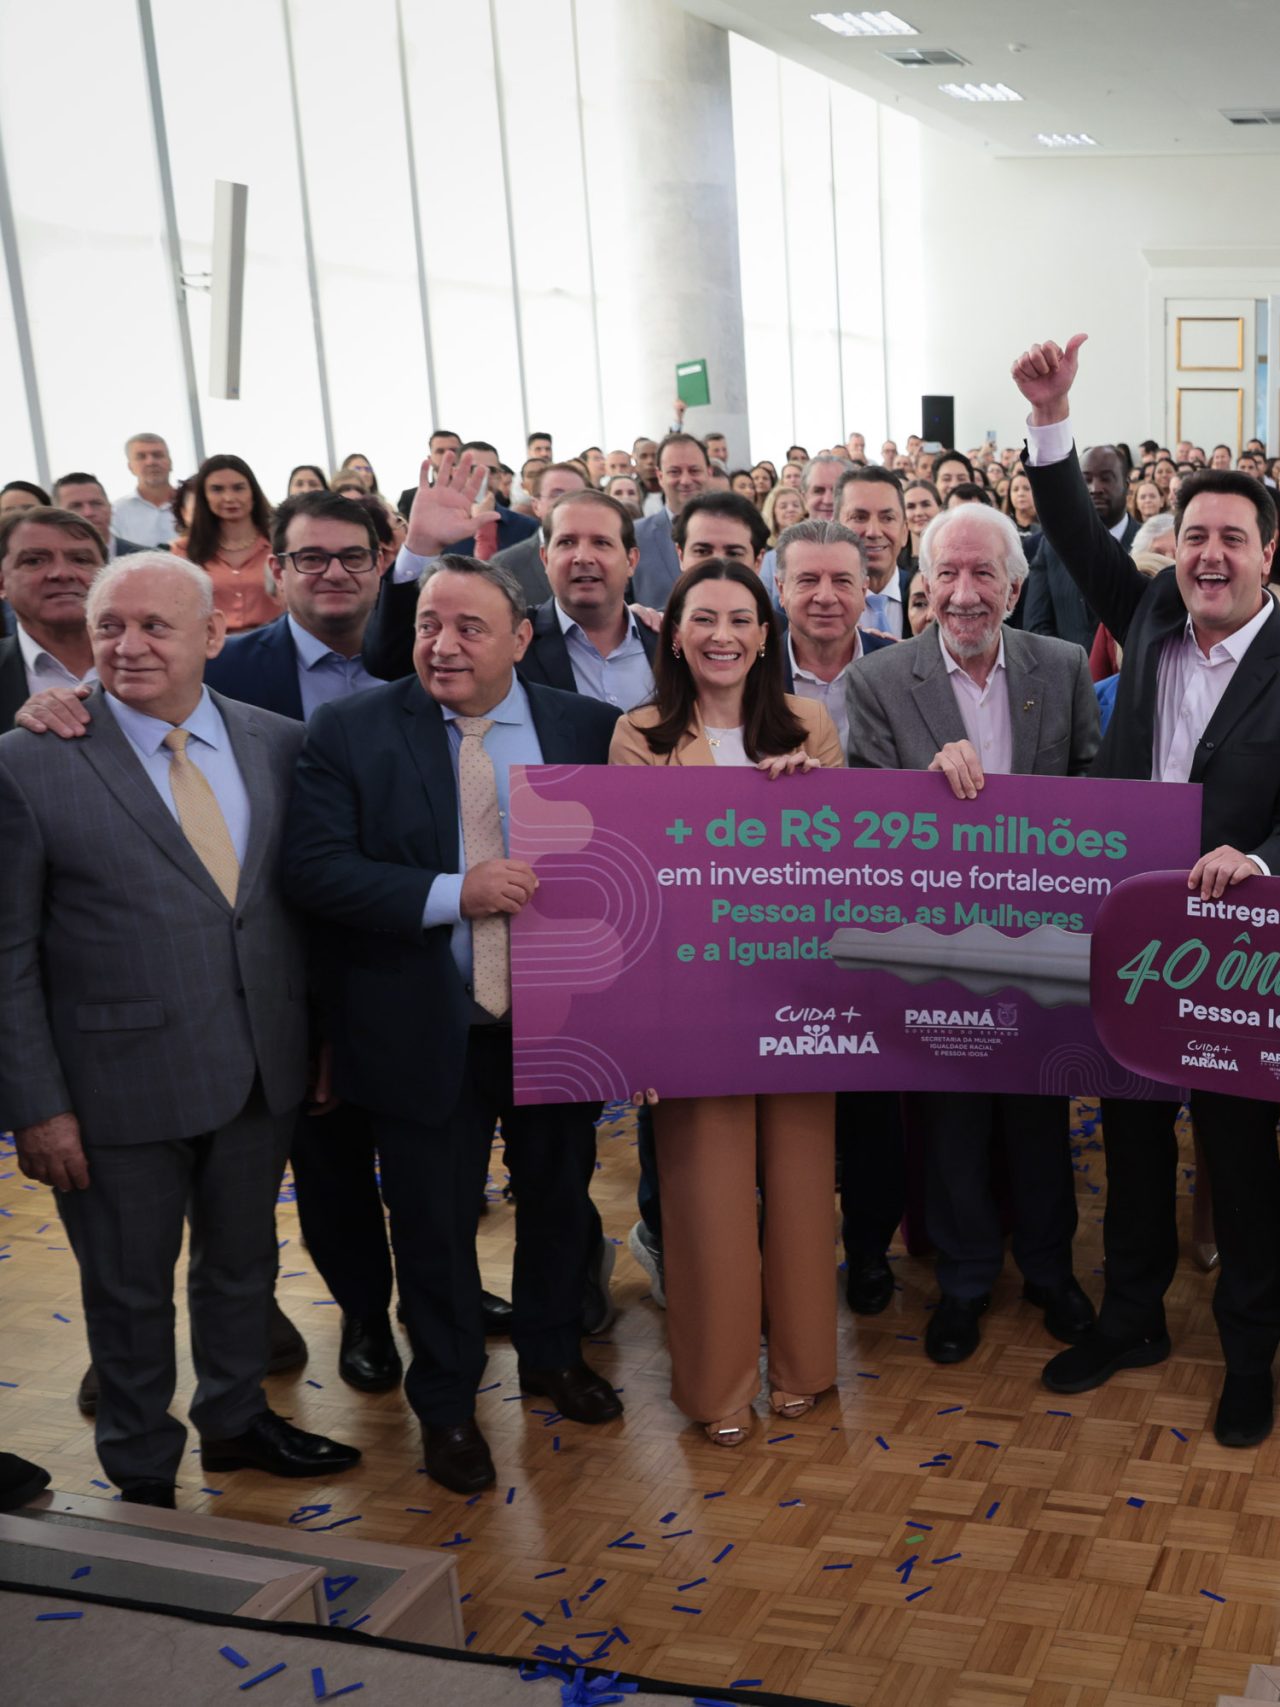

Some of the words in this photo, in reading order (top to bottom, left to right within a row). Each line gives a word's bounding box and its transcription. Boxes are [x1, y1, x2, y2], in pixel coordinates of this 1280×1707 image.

[665, 818, 692, 844] +
[705, 809, 767, 847] de
[781, 805, 841, 852] R$
[853, 810, 939, 850] 295
[952, 814, 1128, 859] milhões
[657, 866, 701, 886] em
[710, 861, 903, 886] investimentos
[910, 868, 962, 892] que
[969, 865, 1111, 896] fortalecem
[711, 899, 815, 923] Pessoa
[824, 899, 908, 925] Idosa,
[915, 904, 946, 924] as
[954, 902, 1084, 930] Mulheres
[1186, 895, 1280, 928] Entrega
[677, 943, 696, 962] e
[703, 942, 720, 961] a
[729, 936, 834, 966] Igualda
[1117, 938, 1211, 1005] 40
[774, 1005, 837, 1023] CUIDA
[905, 1008, 995, 1026] PARANÁ
[1178, 998, 1260, 1026] Pessoa
[759, 1031, 880, 1056] PARANÁ
[1181, 1054, 1239, 1072] PARANÁ
